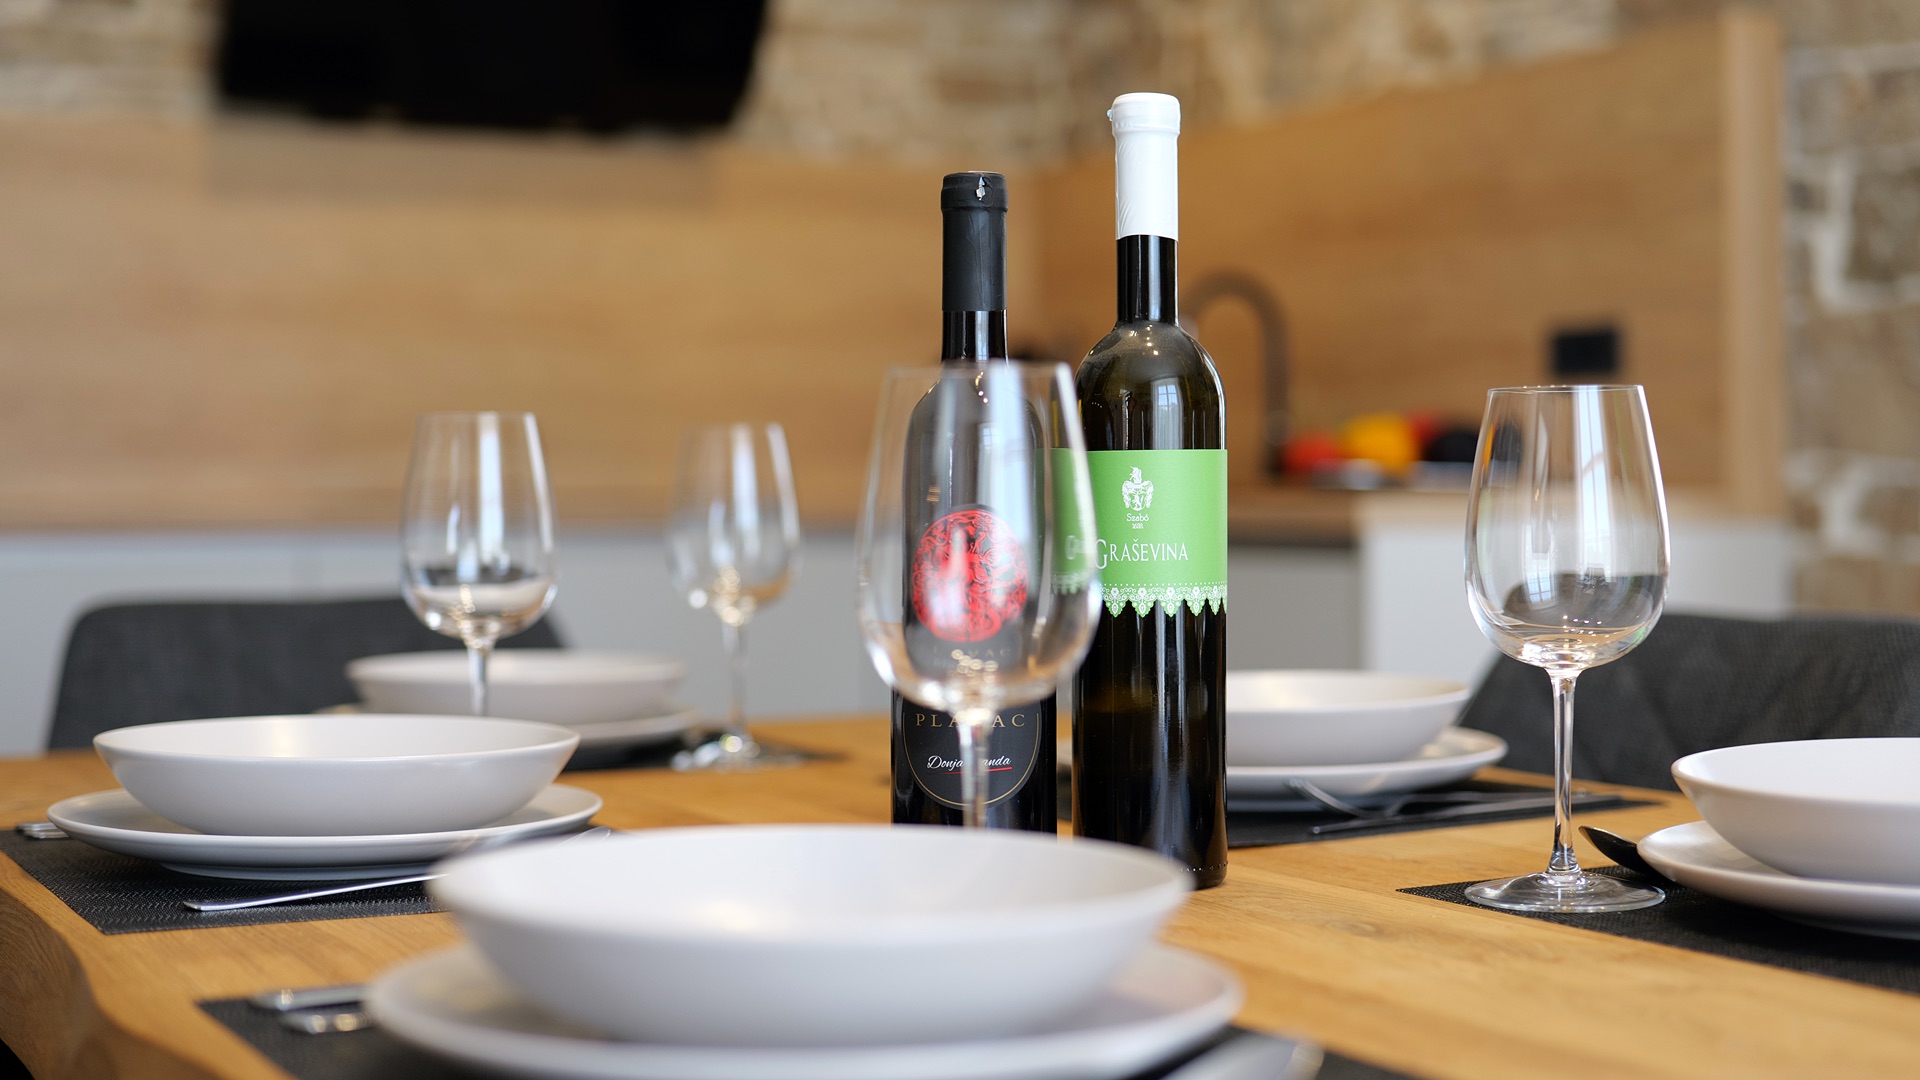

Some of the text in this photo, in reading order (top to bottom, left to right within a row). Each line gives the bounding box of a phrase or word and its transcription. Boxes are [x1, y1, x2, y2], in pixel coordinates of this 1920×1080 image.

[1126, 512, 1149, 522] Szabó
[1095, 538, 1189, 569] GRAŠEVINA
[915, 713, 1025, 728] PLAAC
[927, 755, 1012, 771] Donja anda
